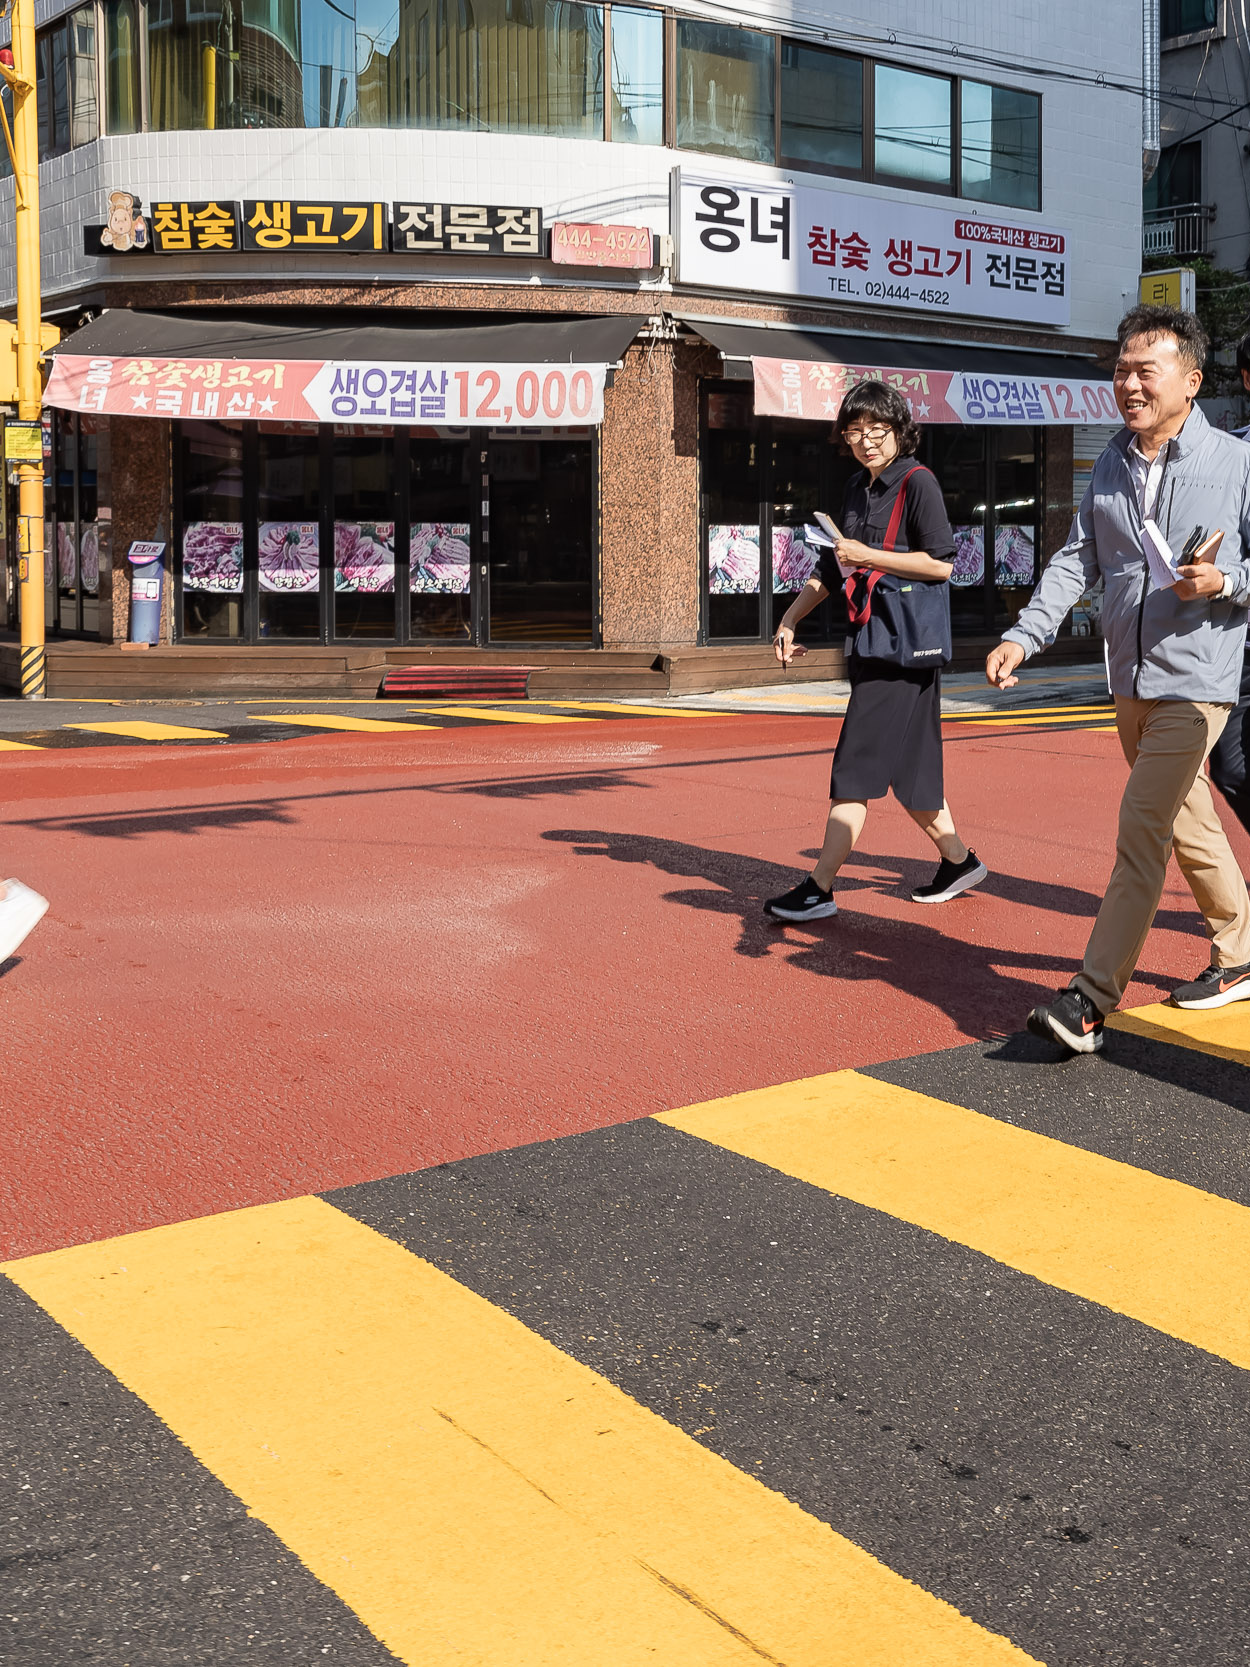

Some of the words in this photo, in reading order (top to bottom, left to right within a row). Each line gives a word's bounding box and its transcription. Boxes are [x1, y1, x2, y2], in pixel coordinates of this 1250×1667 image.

[154, 203, 235, 249] 참숯
[248, 201, 382, 250] 생고기
[397, 204, 539, 253] 전문점
[557, 227, 649, 252] 444-4522
[695, 185, 791, 261] 옹녀
[959, 222, 1025, 246] 100%국내산
[1028, 231, 1061, 252] 생고기
[807, 224, 871, 272] 참숯
[883, 237, 972, 286] 생고기
[985, 252, 1065, 297] 전문점
[827, 276, 860, 296] TEL.
[865, 280, 950, 306] 02)444-4522
[78, 359, 114, 411] 옹녀
[155, 390, 256, 417] 국내산
[329, 368, 449, 418] 생오겹살
[780, 362, 804, 416] 옹녀
[962, 377, 1046, 420] 생오겹살
[1040, 383, 1119, 422] 12,00
